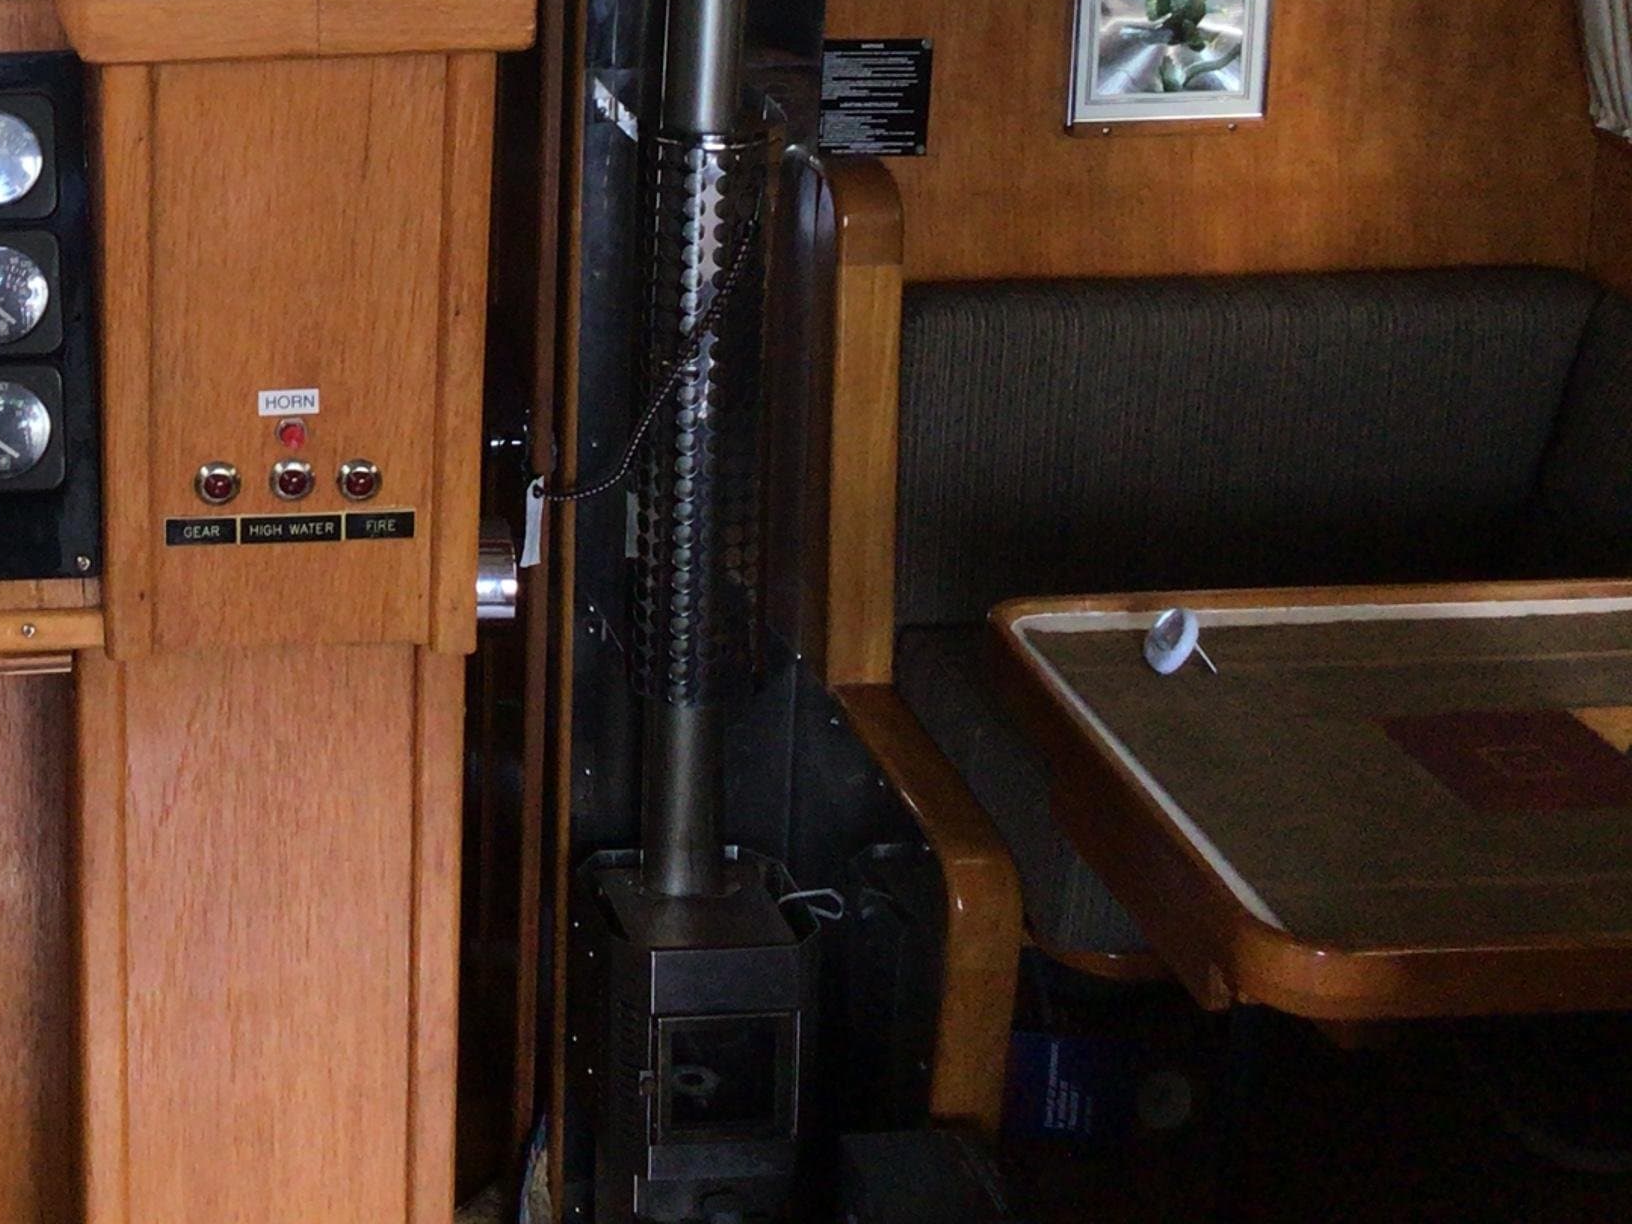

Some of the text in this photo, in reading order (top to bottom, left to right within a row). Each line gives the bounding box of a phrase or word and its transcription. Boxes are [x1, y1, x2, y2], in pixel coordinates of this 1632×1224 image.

[264, 394, 316, 410] HORN
[183, 526, 220, 538] GEAR
[248, 521, 335, 537] HIGH WATER
[365, 519, 397, 532] FIRE
